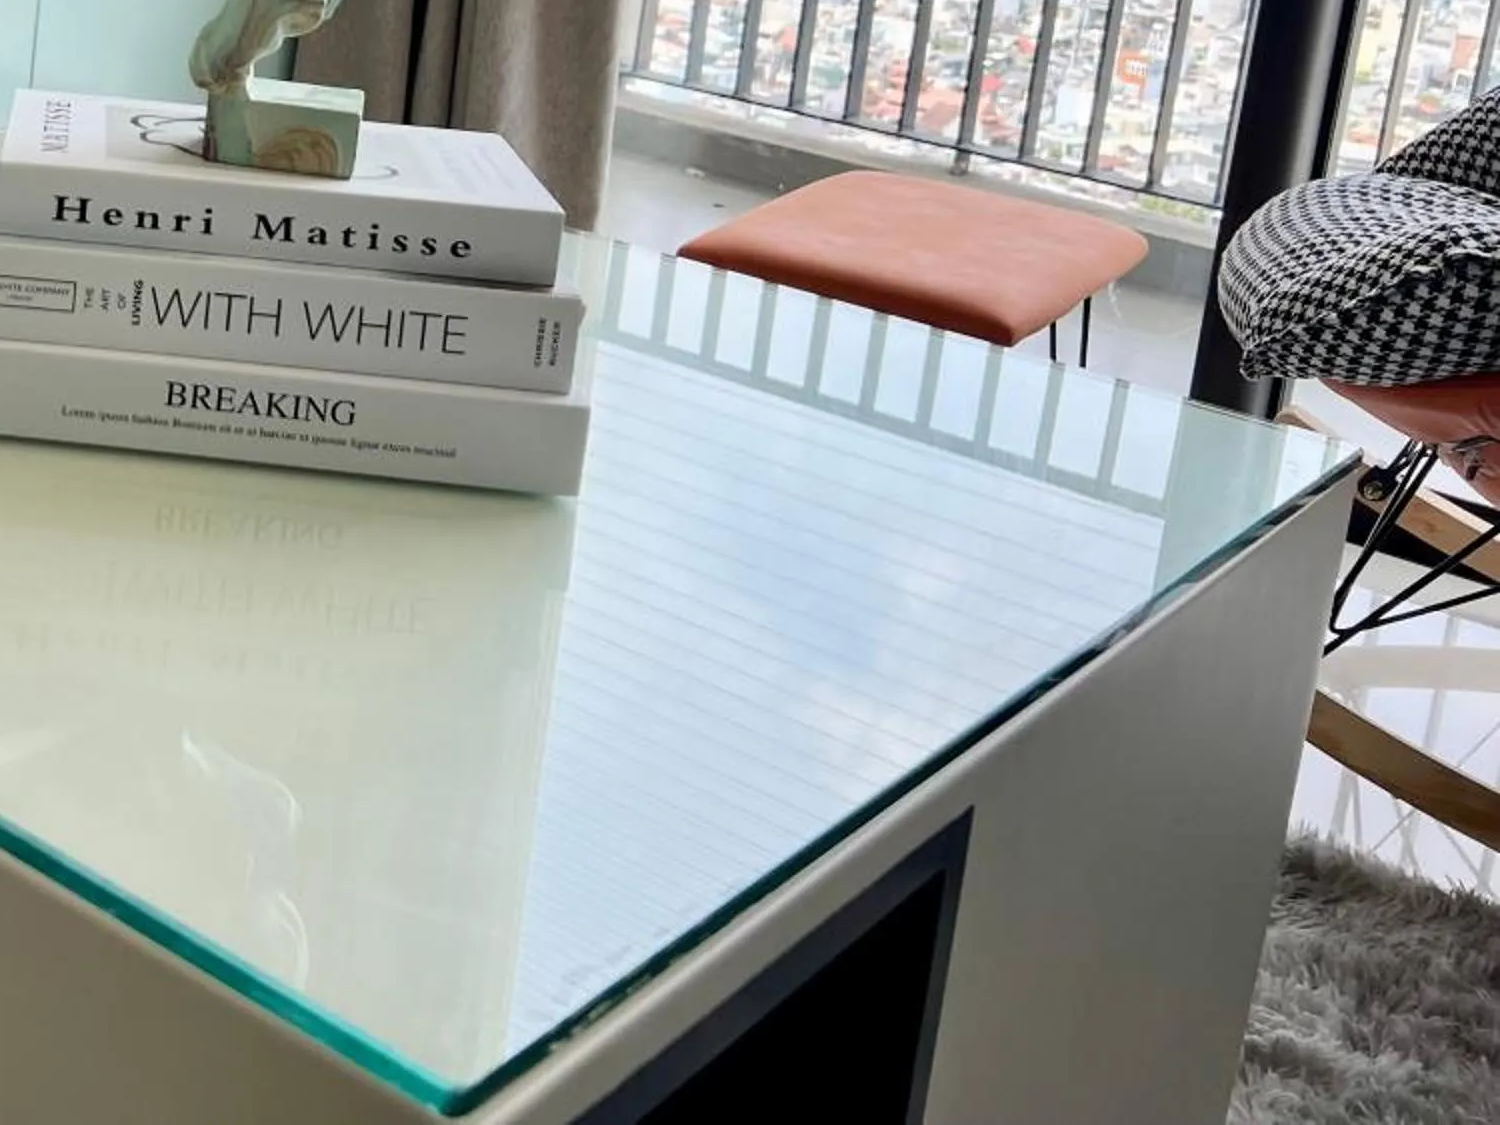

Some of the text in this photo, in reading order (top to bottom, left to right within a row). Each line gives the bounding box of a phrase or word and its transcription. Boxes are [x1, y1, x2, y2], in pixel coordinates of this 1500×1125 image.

[51, 194, 472, 258] Henri Matisse
[131, 279, 144, 326] LIVING
[150, 286, 470, 356] WITH WHITE
[164, 380, 357, 426] BREAKING
